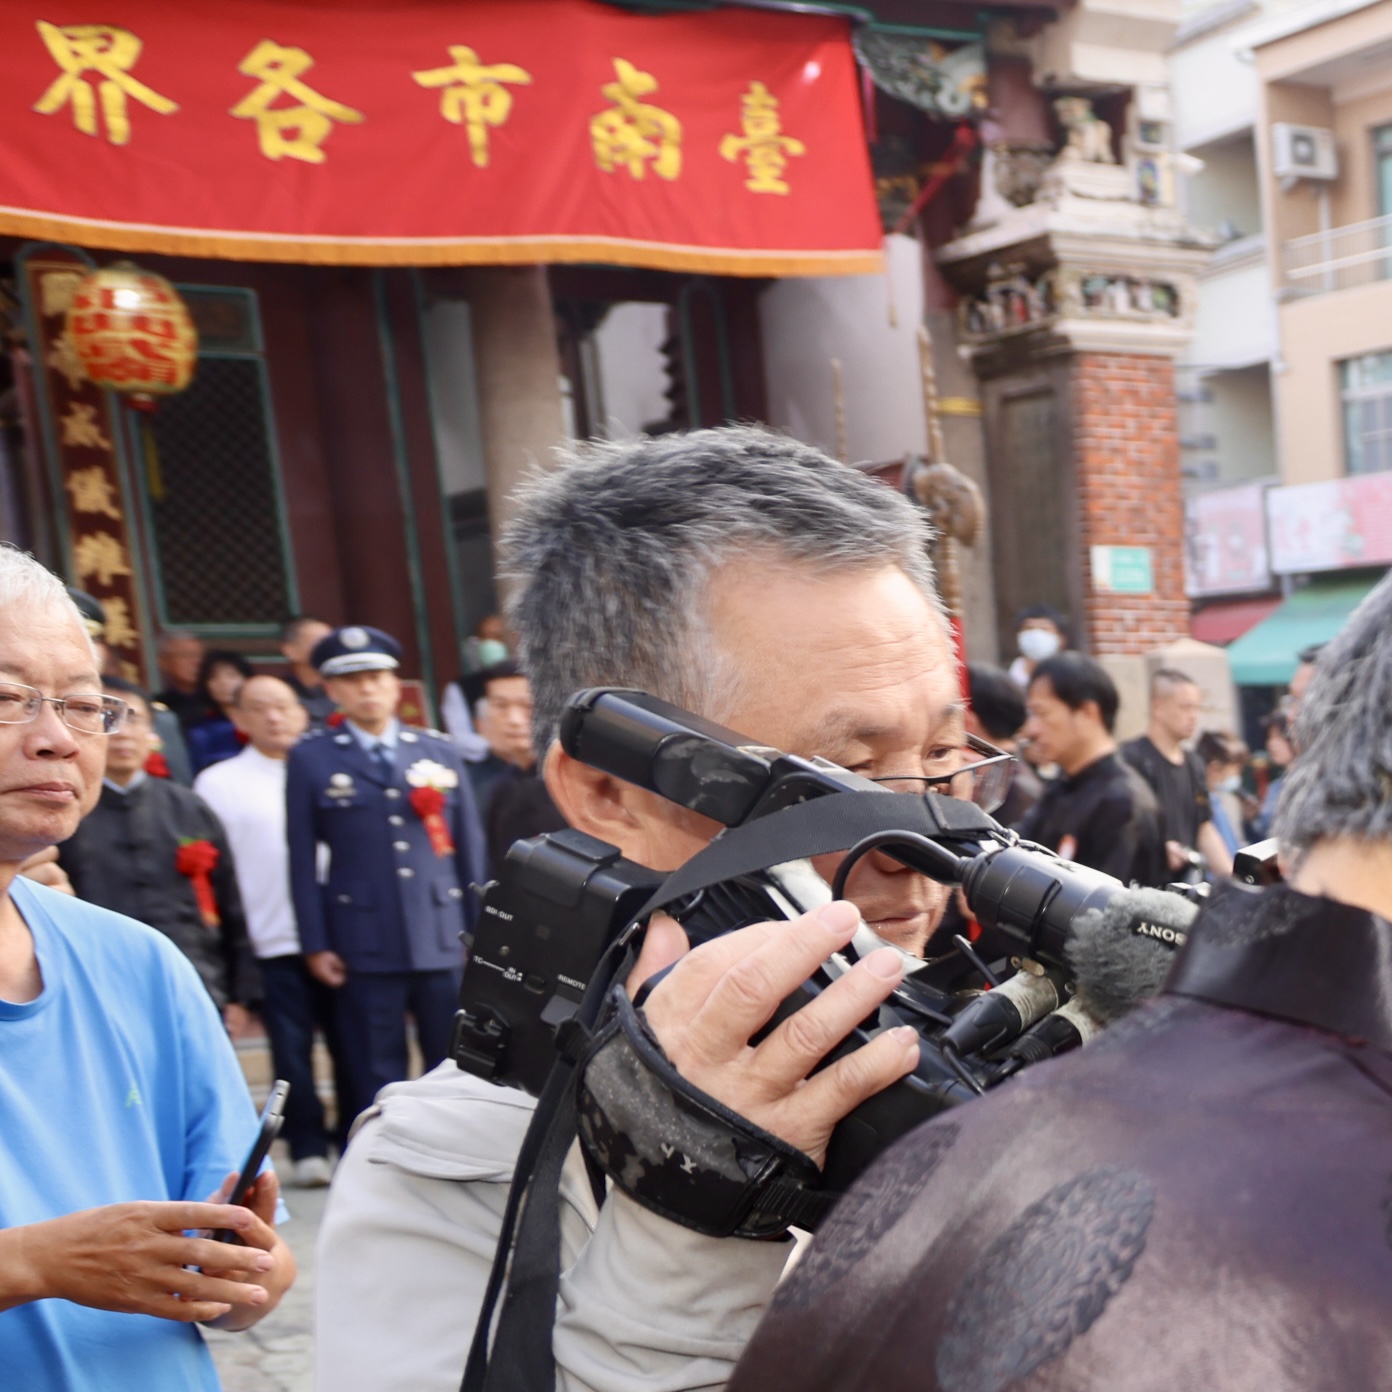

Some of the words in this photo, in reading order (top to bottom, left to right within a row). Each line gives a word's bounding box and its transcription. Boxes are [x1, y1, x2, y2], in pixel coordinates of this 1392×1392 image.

[499, 910, 513, 920] OUT
[1137, 922, 1187, 946] SONY
[558, 974, 586, 990] REMOTE
